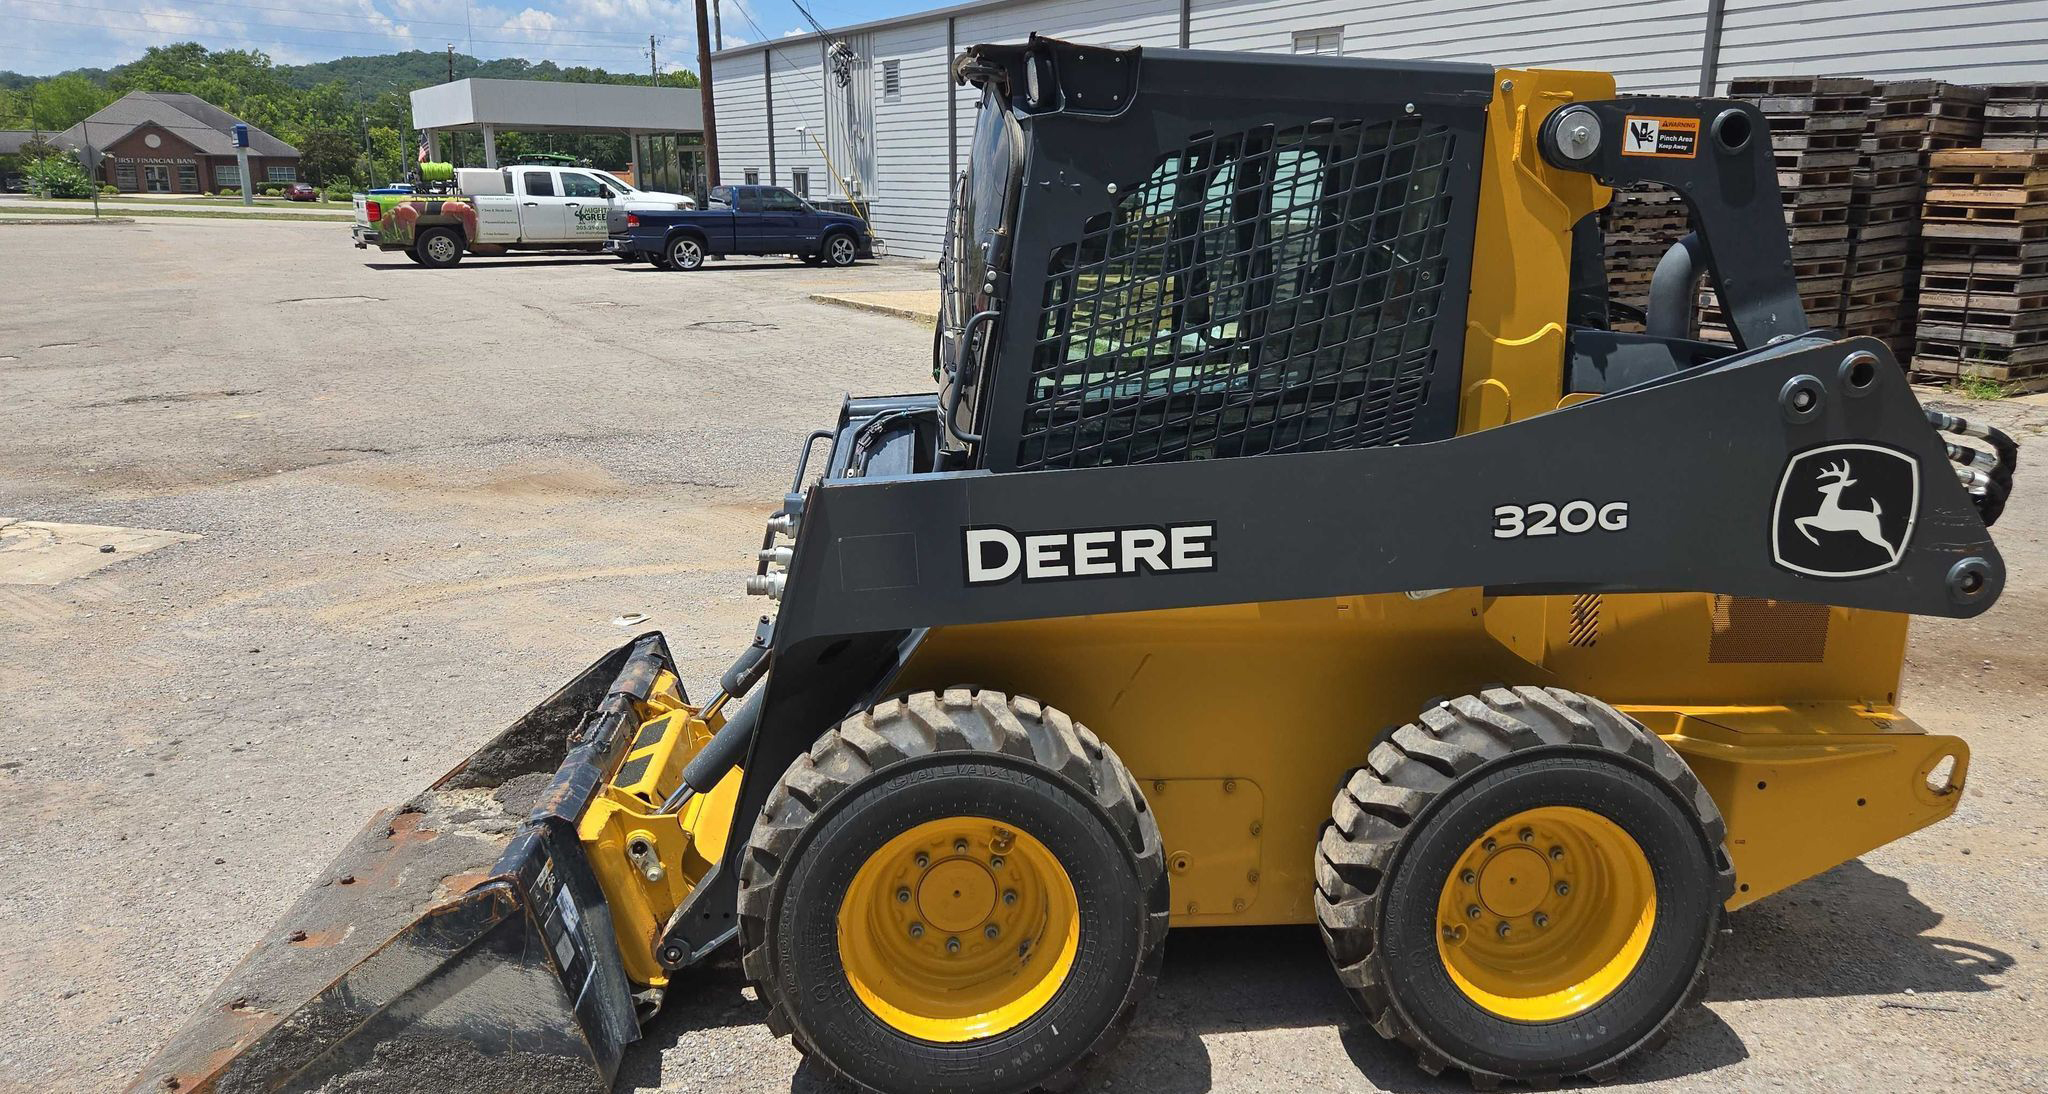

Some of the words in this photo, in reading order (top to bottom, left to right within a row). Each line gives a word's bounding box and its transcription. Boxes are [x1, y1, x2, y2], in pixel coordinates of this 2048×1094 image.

[1660, 134, 1678, 142] Pinch
[1678, 135, 1693, 143] Area
[584, 213, 607, 221] GREE
[1494, 500, 1628, 538] 320G
[966, 525, 1213, 582] DEERE
